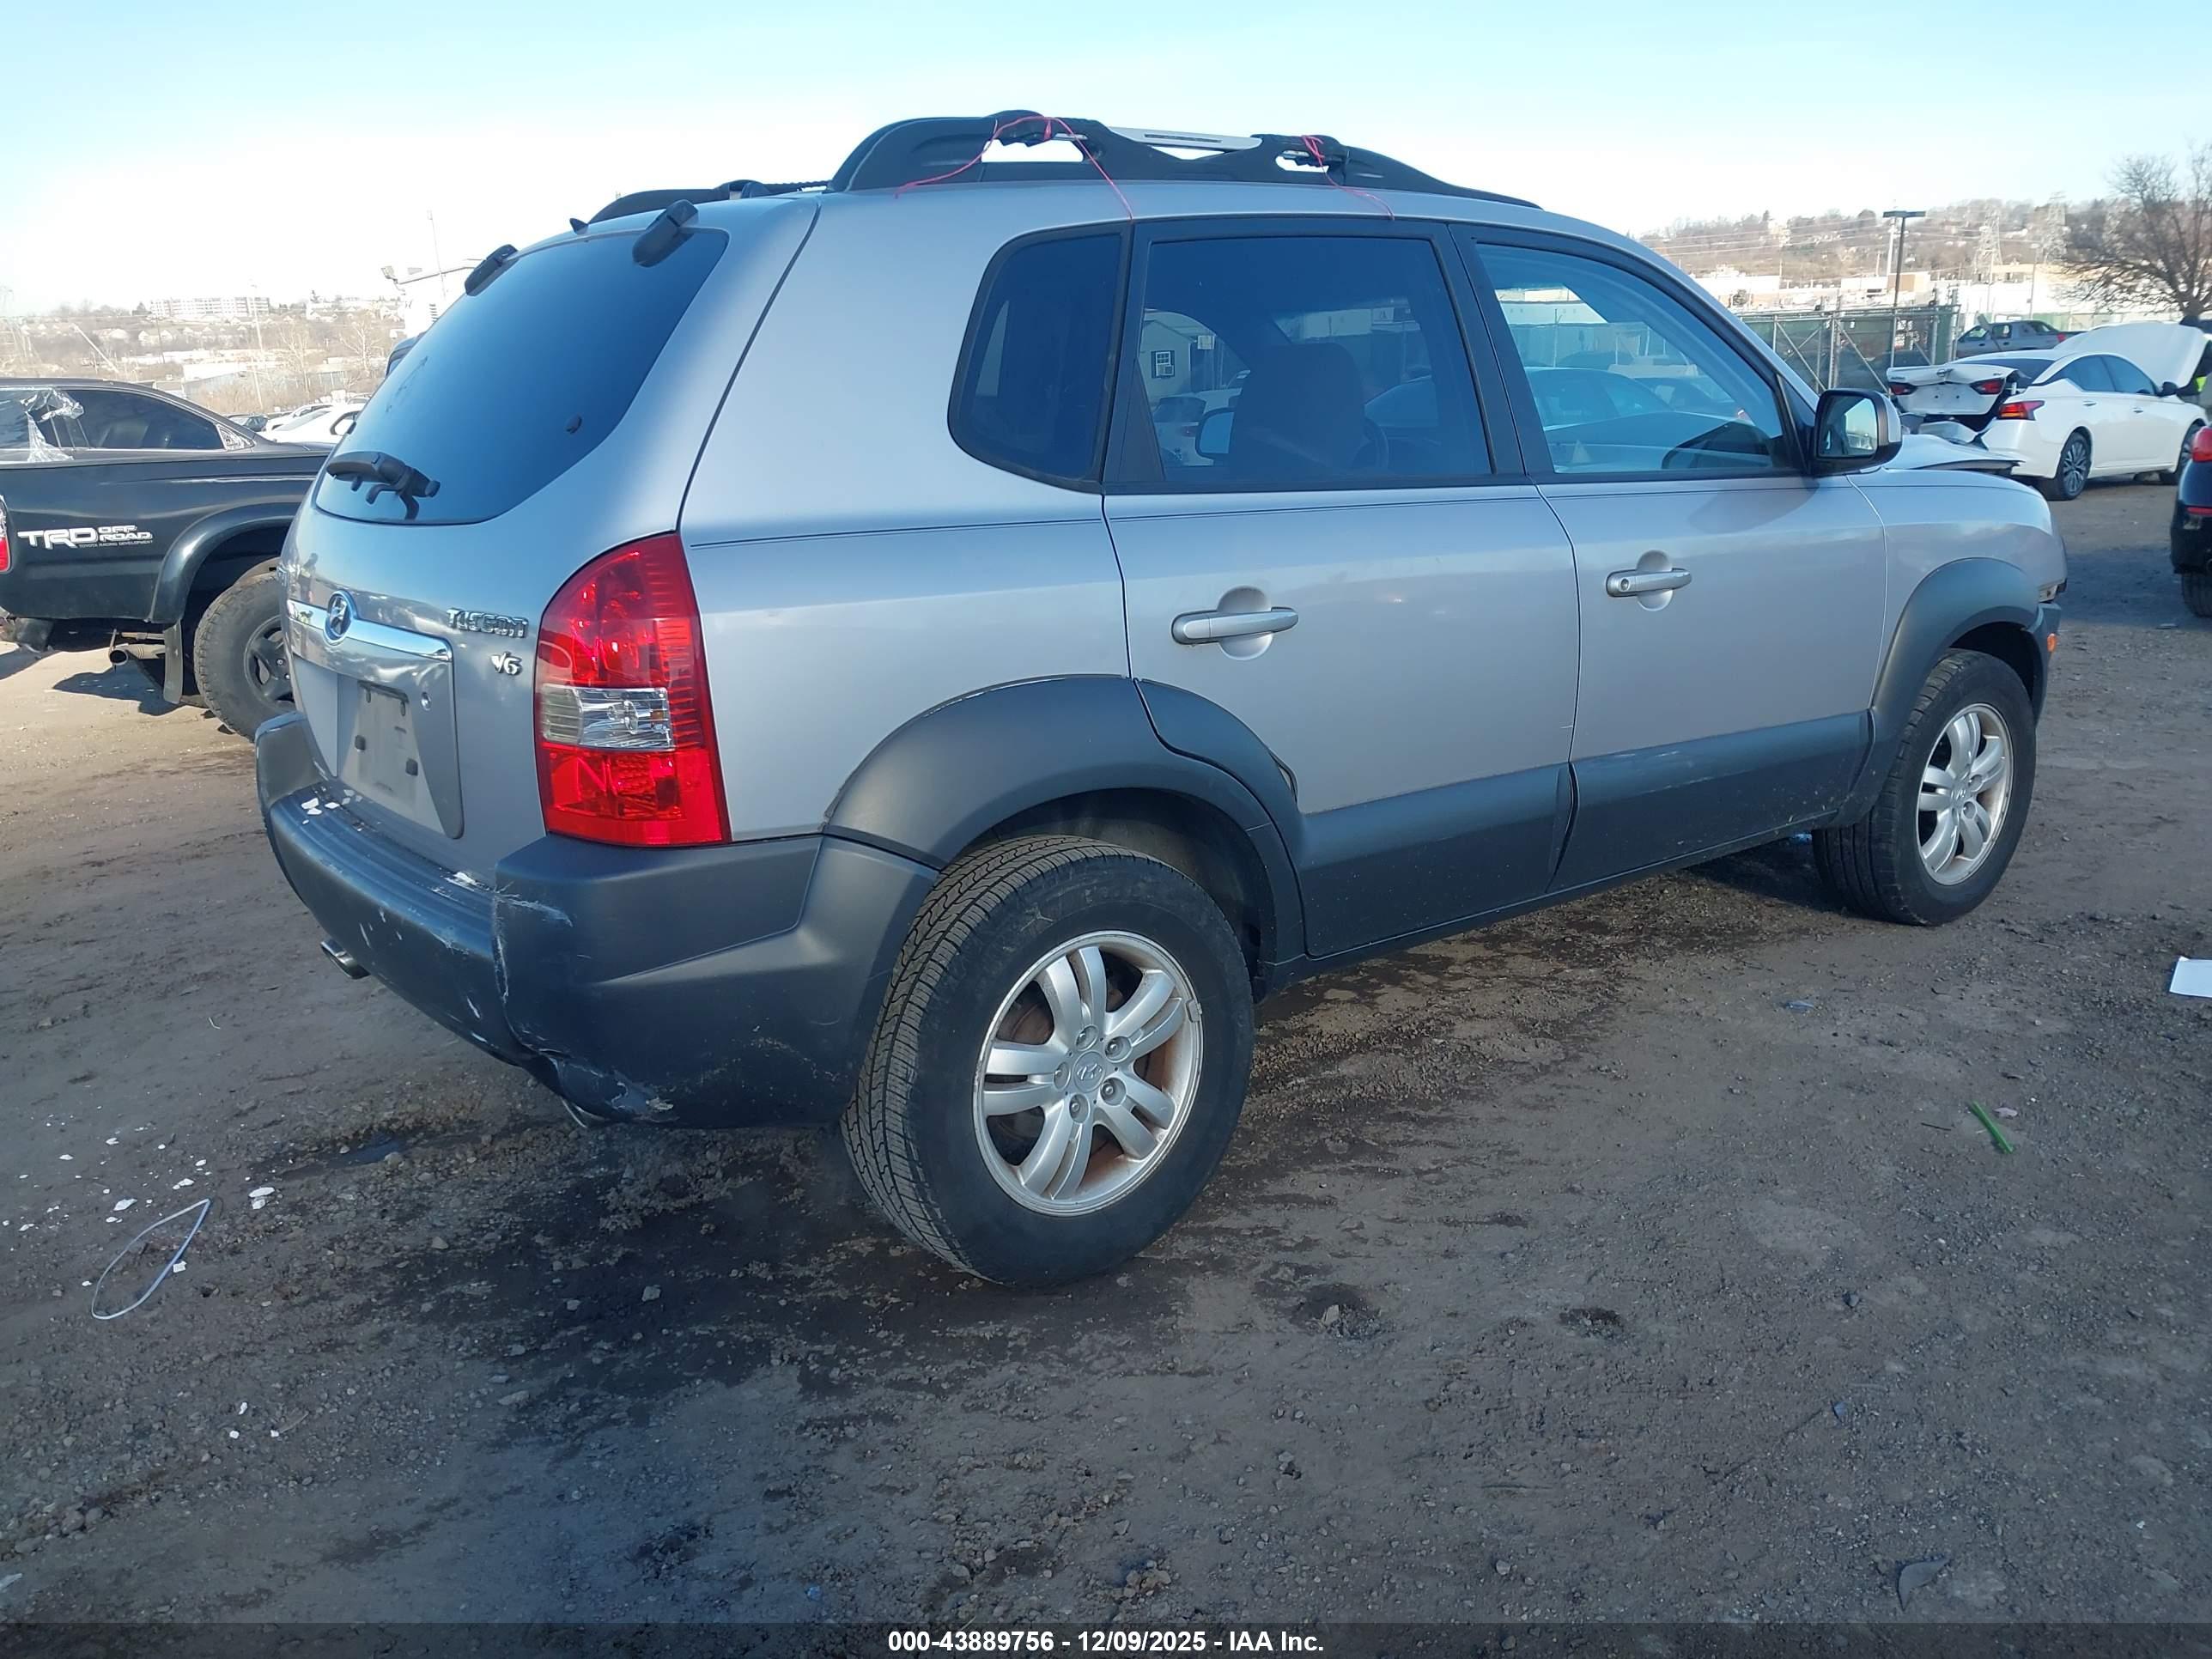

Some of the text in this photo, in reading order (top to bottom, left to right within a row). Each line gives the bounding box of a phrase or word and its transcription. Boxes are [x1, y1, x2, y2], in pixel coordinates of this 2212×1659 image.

[98, 525, 137, 534] OFF
[99, 532, 153, 542] ROAD
[17, 527, 99, 550] TRD
[490, 652, 523, 676] V6
